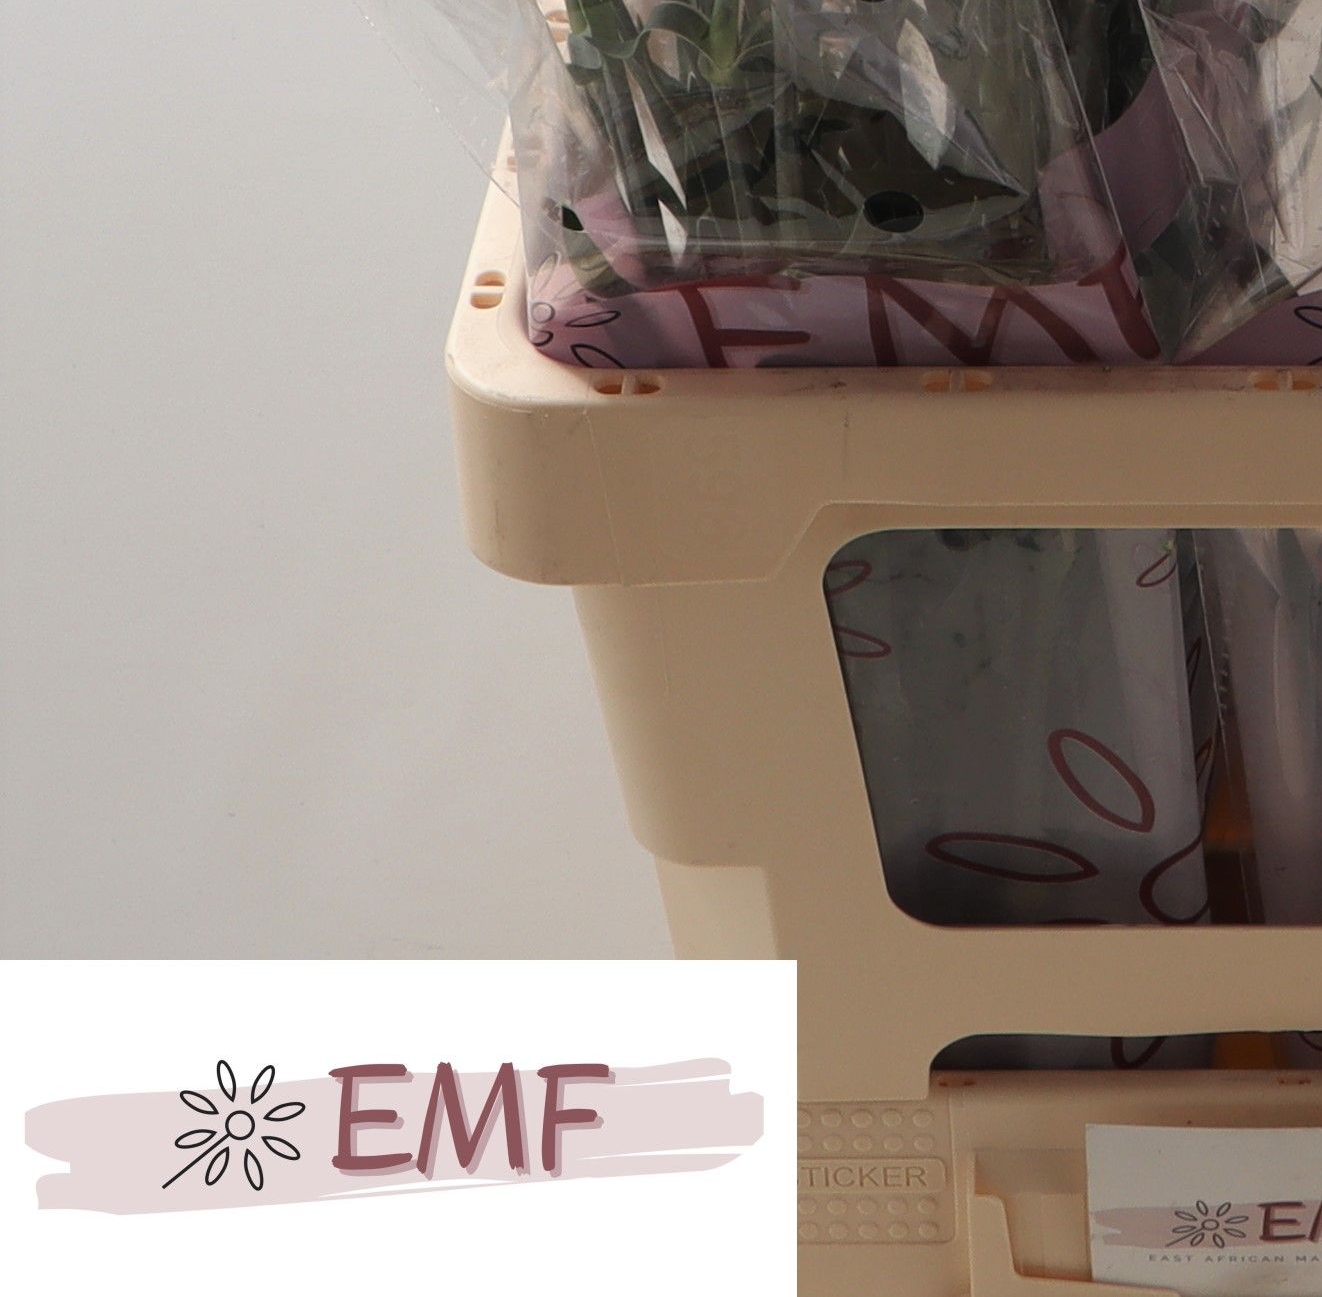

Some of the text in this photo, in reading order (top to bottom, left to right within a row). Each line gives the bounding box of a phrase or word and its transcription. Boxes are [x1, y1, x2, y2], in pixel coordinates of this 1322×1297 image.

[797, 1165, 928, 1188] TICKER
[1148, 1253, 1194, 1263] EAST
[1204, 1254, 1285, 1263] AFRICAN
